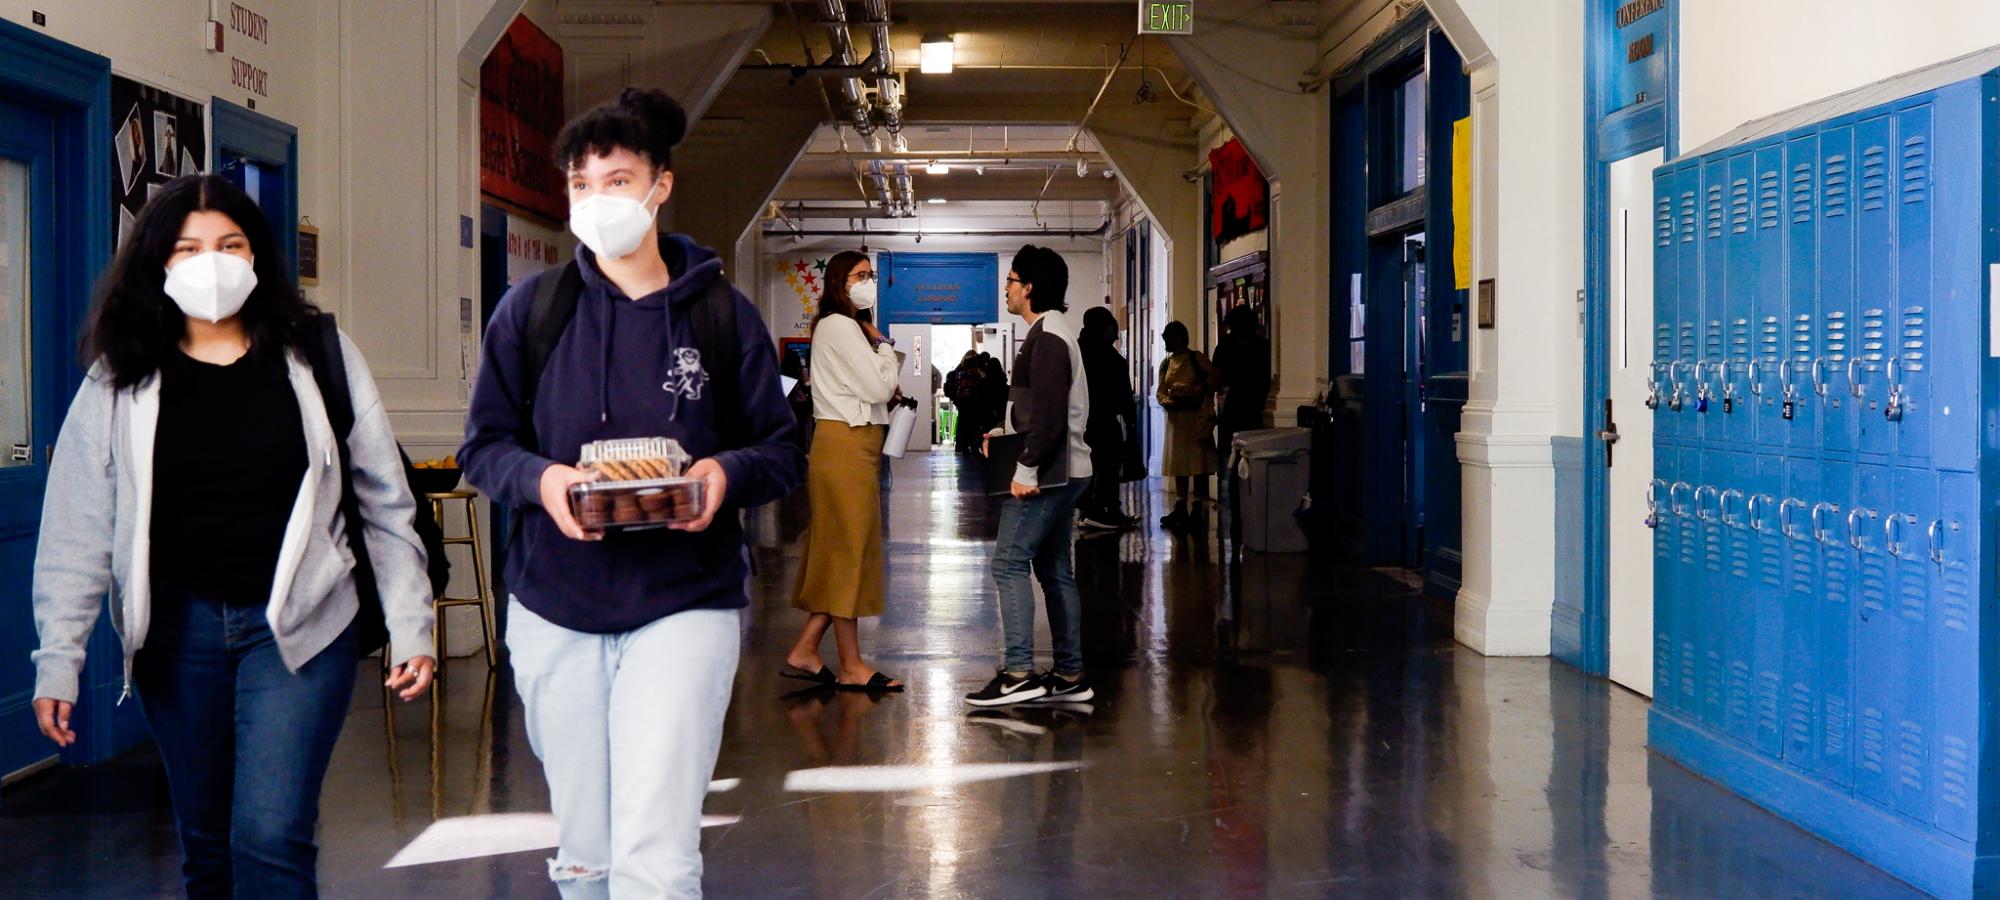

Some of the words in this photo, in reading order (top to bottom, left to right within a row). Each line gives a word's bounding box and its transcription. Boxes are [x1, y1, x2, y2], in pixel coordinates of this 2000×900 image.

[230, 2, 268, 44] STUDENT
[1150, 3, 1187, 30] EXIT
[231, 56, 268, 97] SUPPORT
